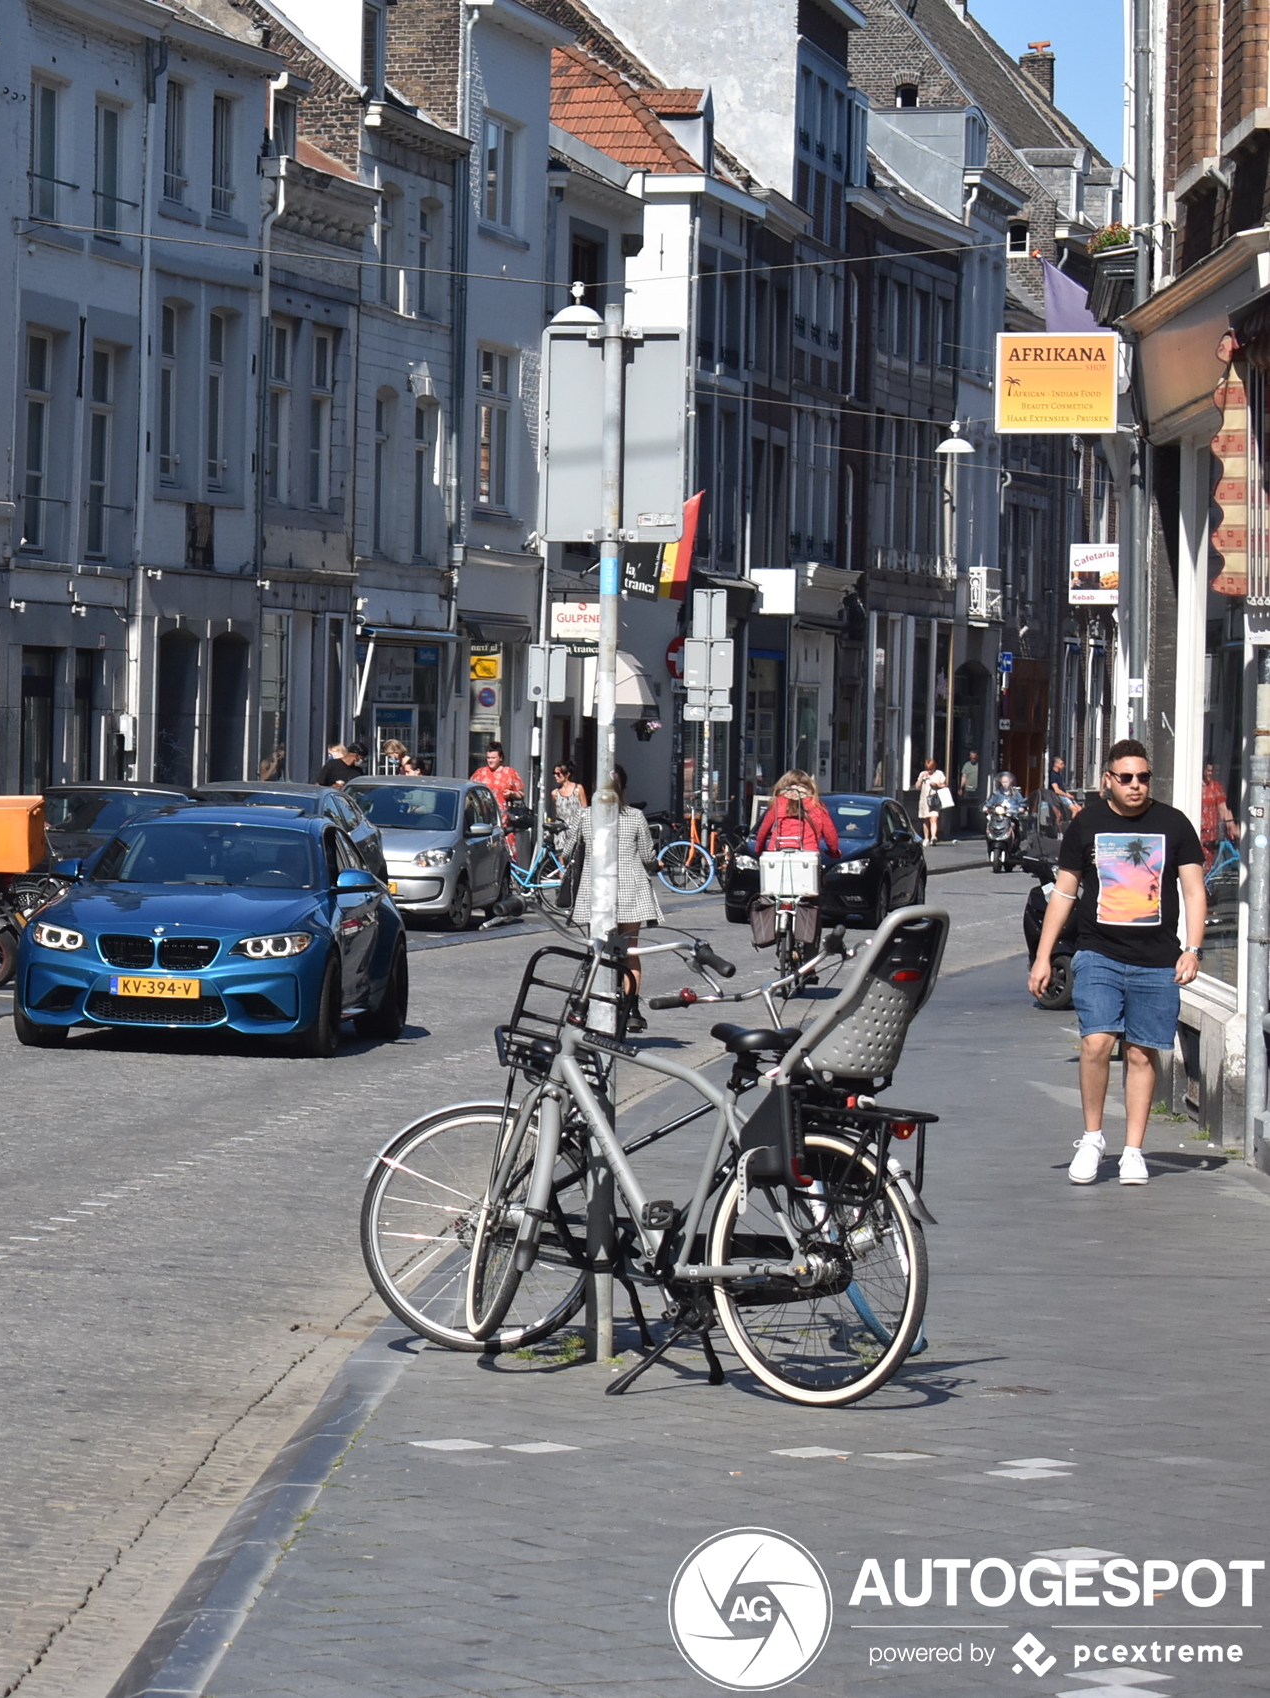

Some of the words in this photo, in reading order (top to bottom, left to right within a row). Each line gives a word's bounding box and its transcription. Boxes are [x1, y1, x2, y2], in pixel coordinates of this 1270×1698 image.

[1008, 347, 1107, 361] AFRIKANA
[1013, 390, 1045, 398] AFRICAN
[1052, 390, 1079, 398] INDIAN
[1080, 390, 1102, 398] FOOD
[1021, 402, 1049, 410] BEAUTY
[1050, 402, 1093, 410] COSMETICS
[1007, 414, 1028, 422] HAAR
[1076, 414, 1109, 422] PRUIKEN
[1073, 550, 1115, 567] Cafetaria
[624, 577, 655, 594] tranca
[556, 612, 600, 623] GULPENE
[122, 979, 192, 996] KV-394-V
